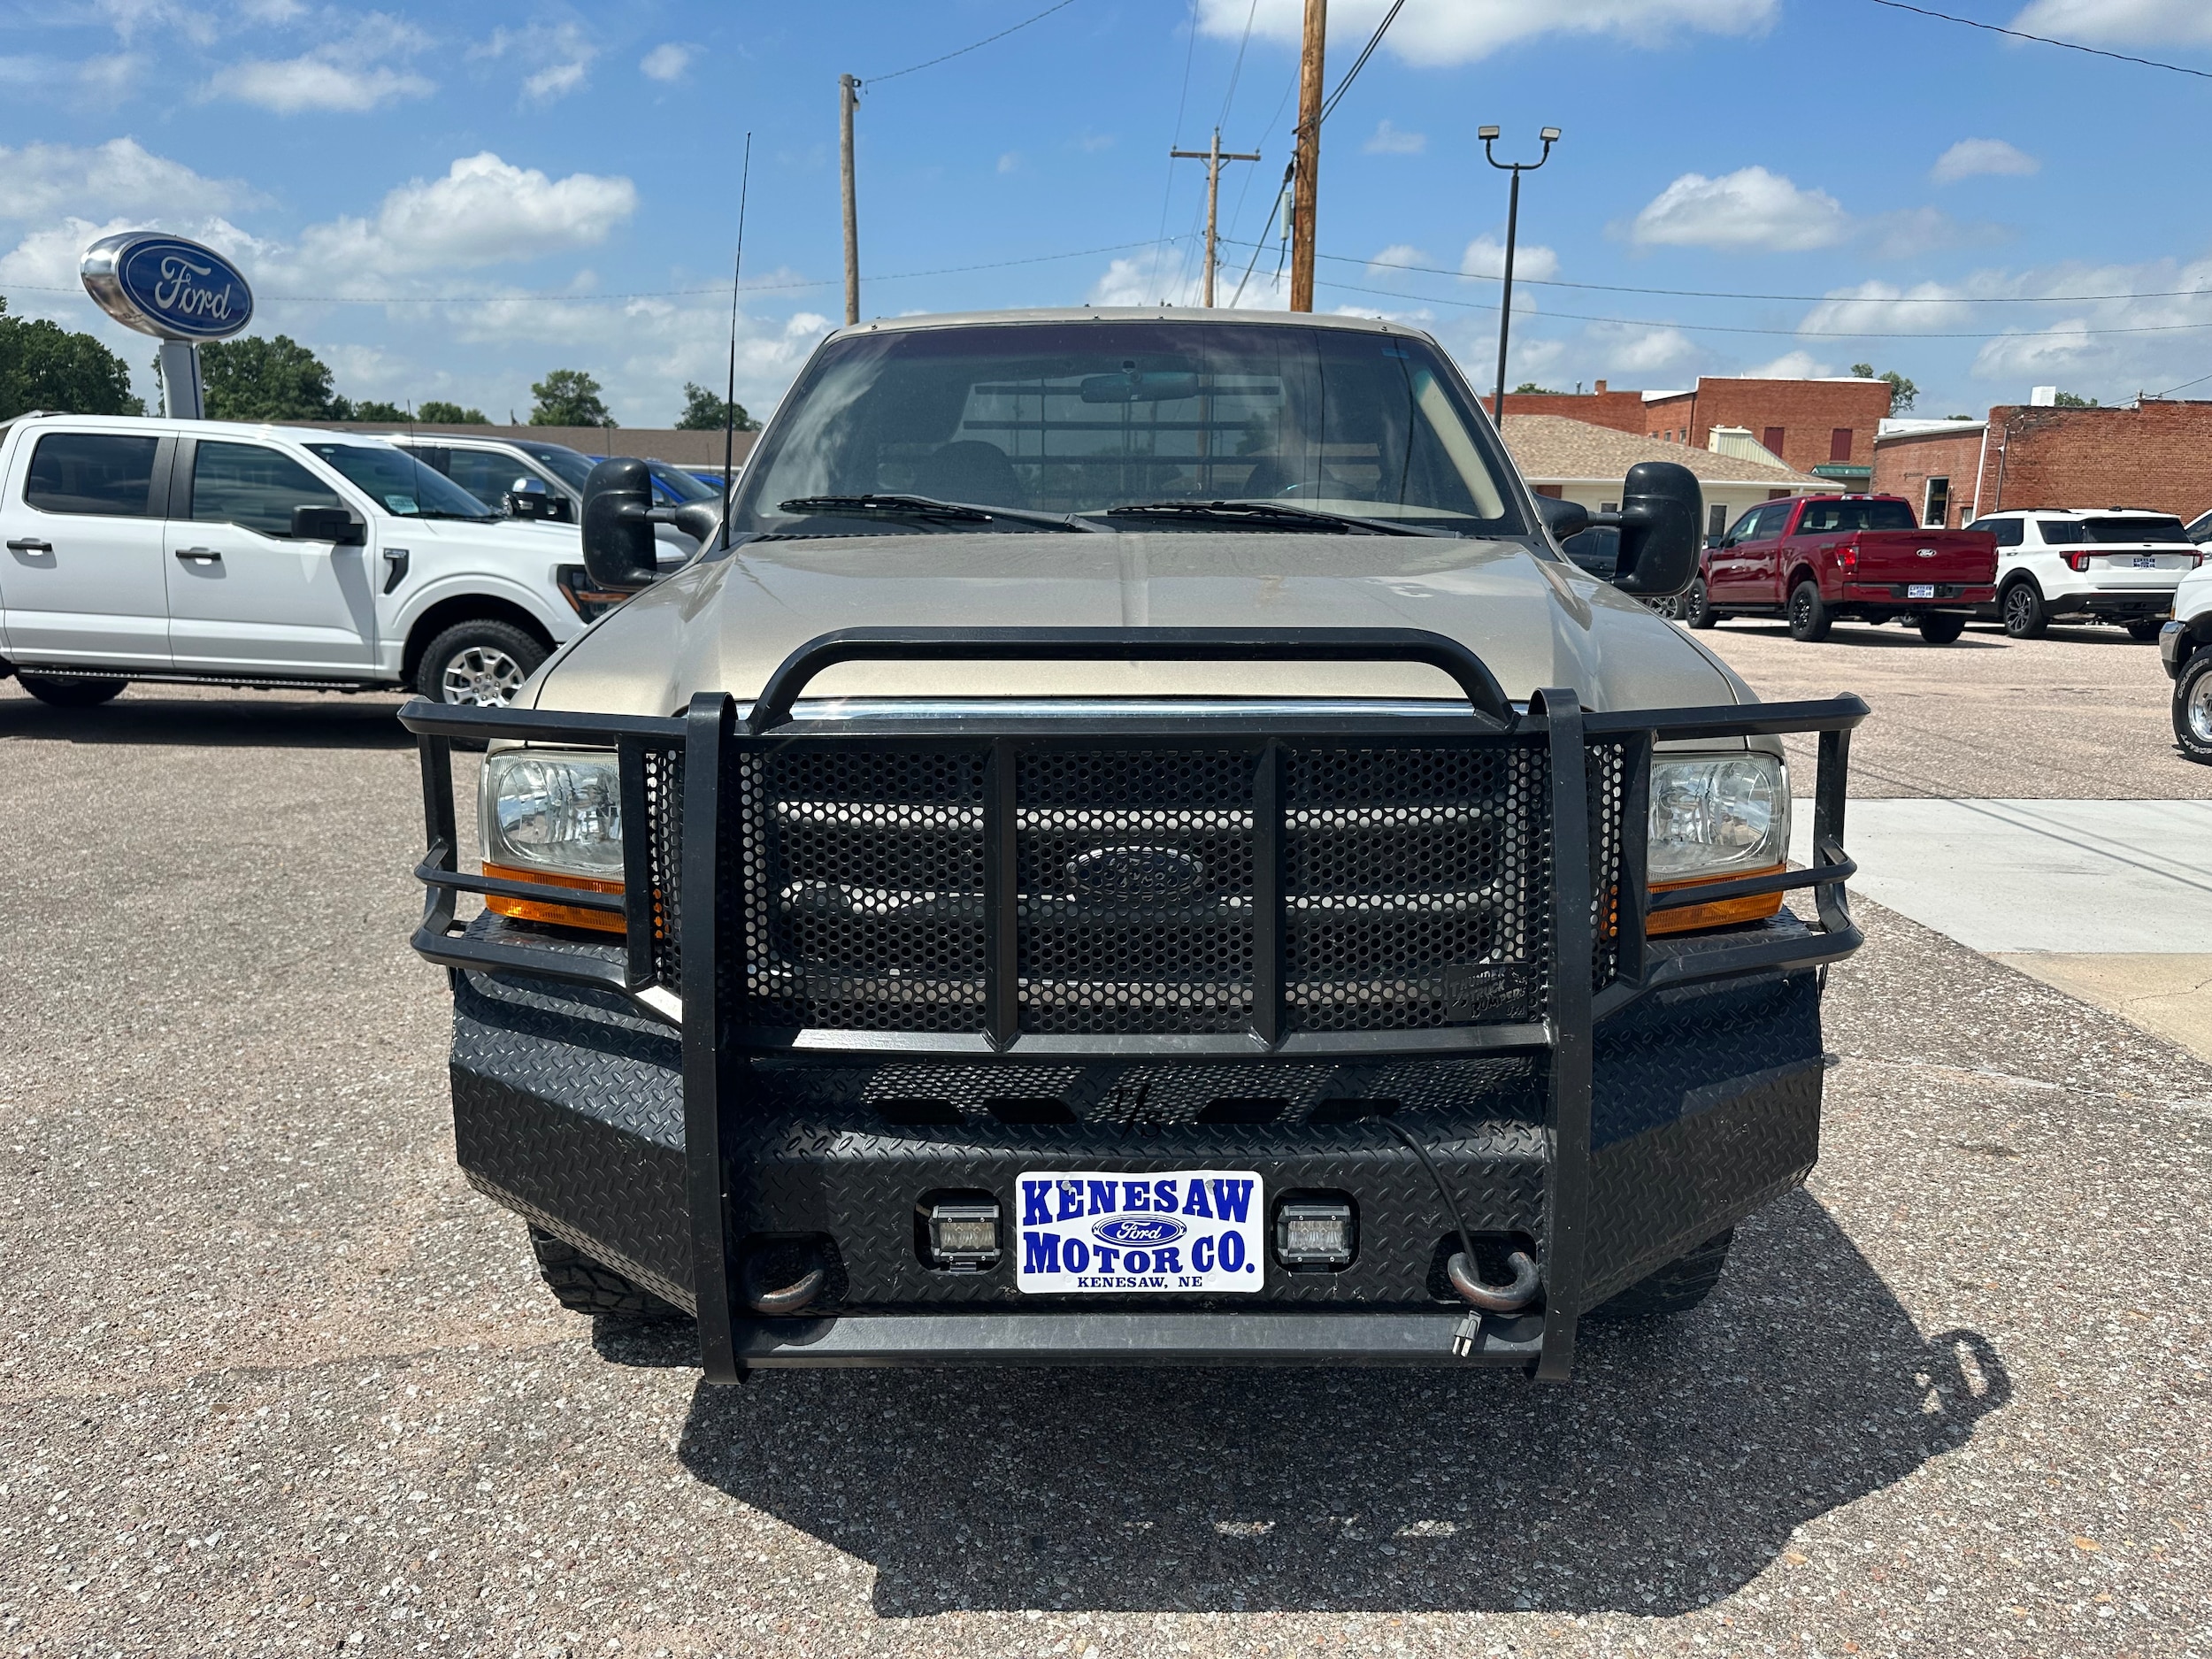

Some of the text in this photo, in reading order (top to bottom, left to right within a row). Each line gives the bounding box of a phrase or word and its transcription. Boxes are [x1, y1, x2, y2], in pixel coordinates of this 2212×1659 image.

[154, 256, 232, 320] Ford
[1450, 966, 1506, 997] THUNDER
[1471, 987, 1526, 1019] BUMPERS
[1022, 1179, 1254, 1226] KENESAW
[1116, 1221, 1163, 1240] Ford
[1023, 1230, 1256, 1274] MOTOR CO.
[1077, 1276, 1203, 1289] KENESAW, NE
